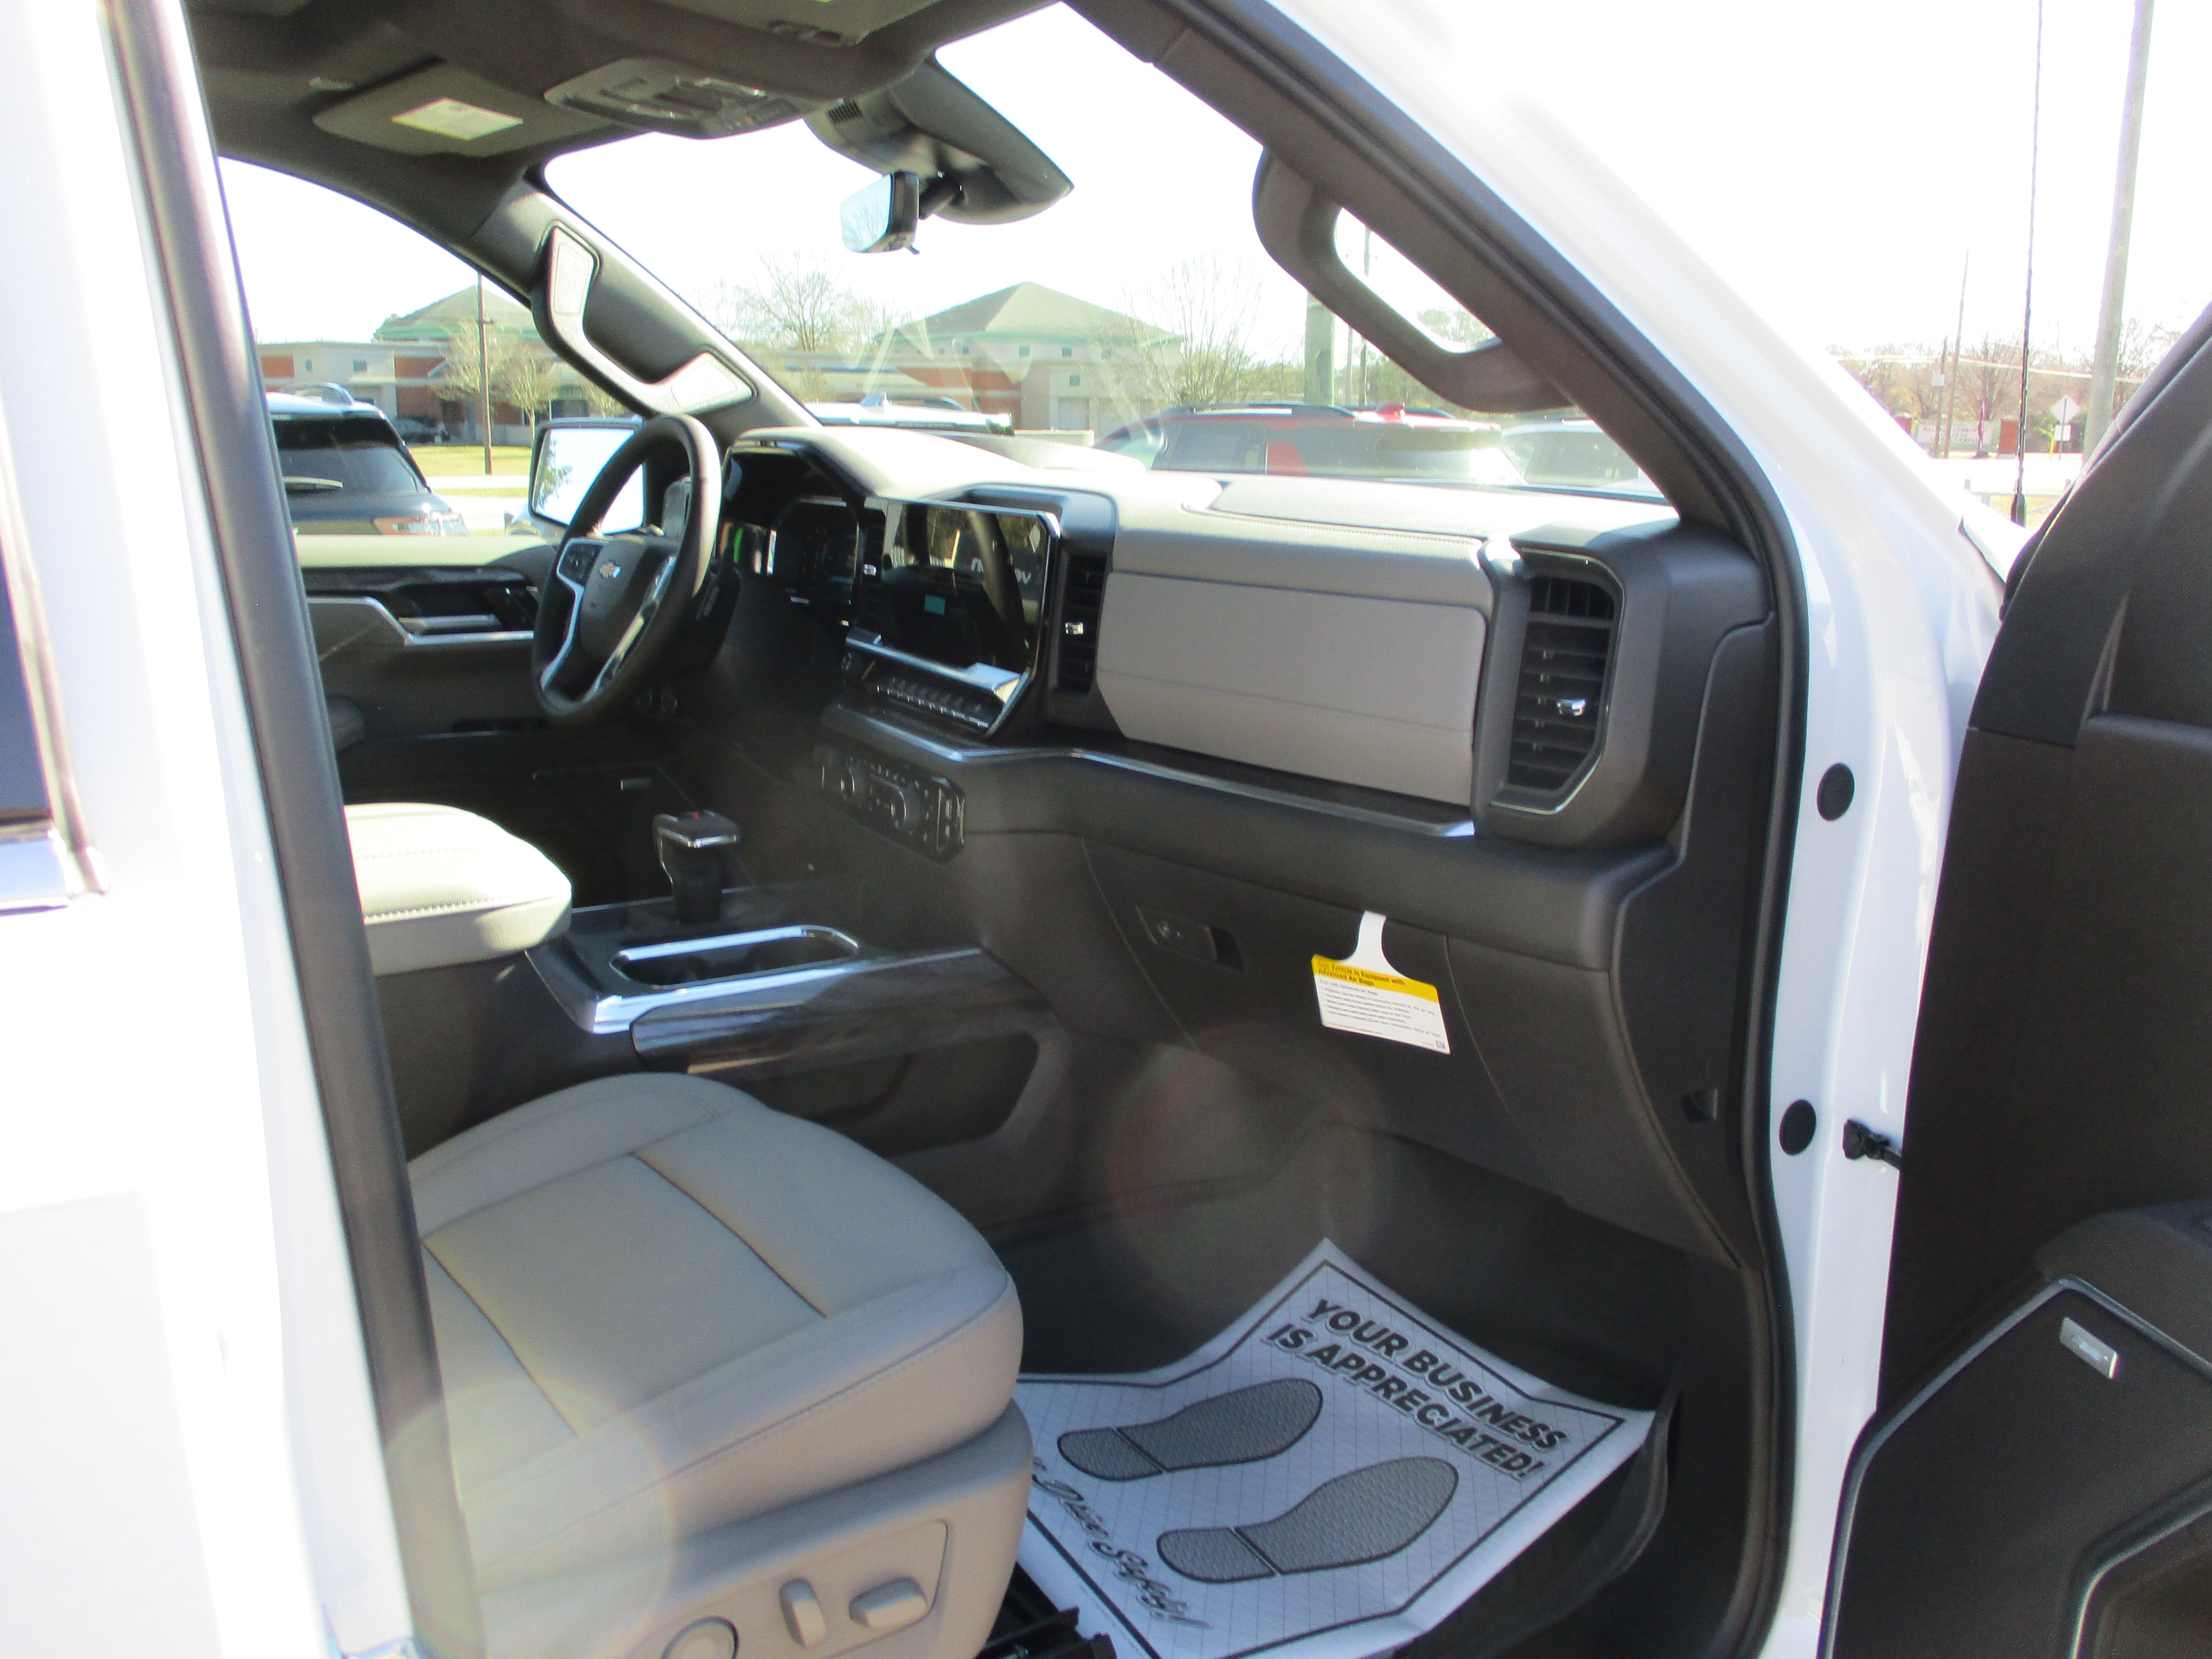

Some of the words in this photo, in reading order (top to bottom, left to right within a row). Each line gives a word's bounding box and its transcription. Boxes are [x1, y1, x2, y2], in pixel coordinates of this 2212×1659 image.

[1266, 1322, 1315, 1349] IS
[1305, 1343, 1546, 1479] APPRECIATED!
[1307, 1298, 1410, 1360] YOUR
[1402, 1348, 1568, 1450] BUSINESS
